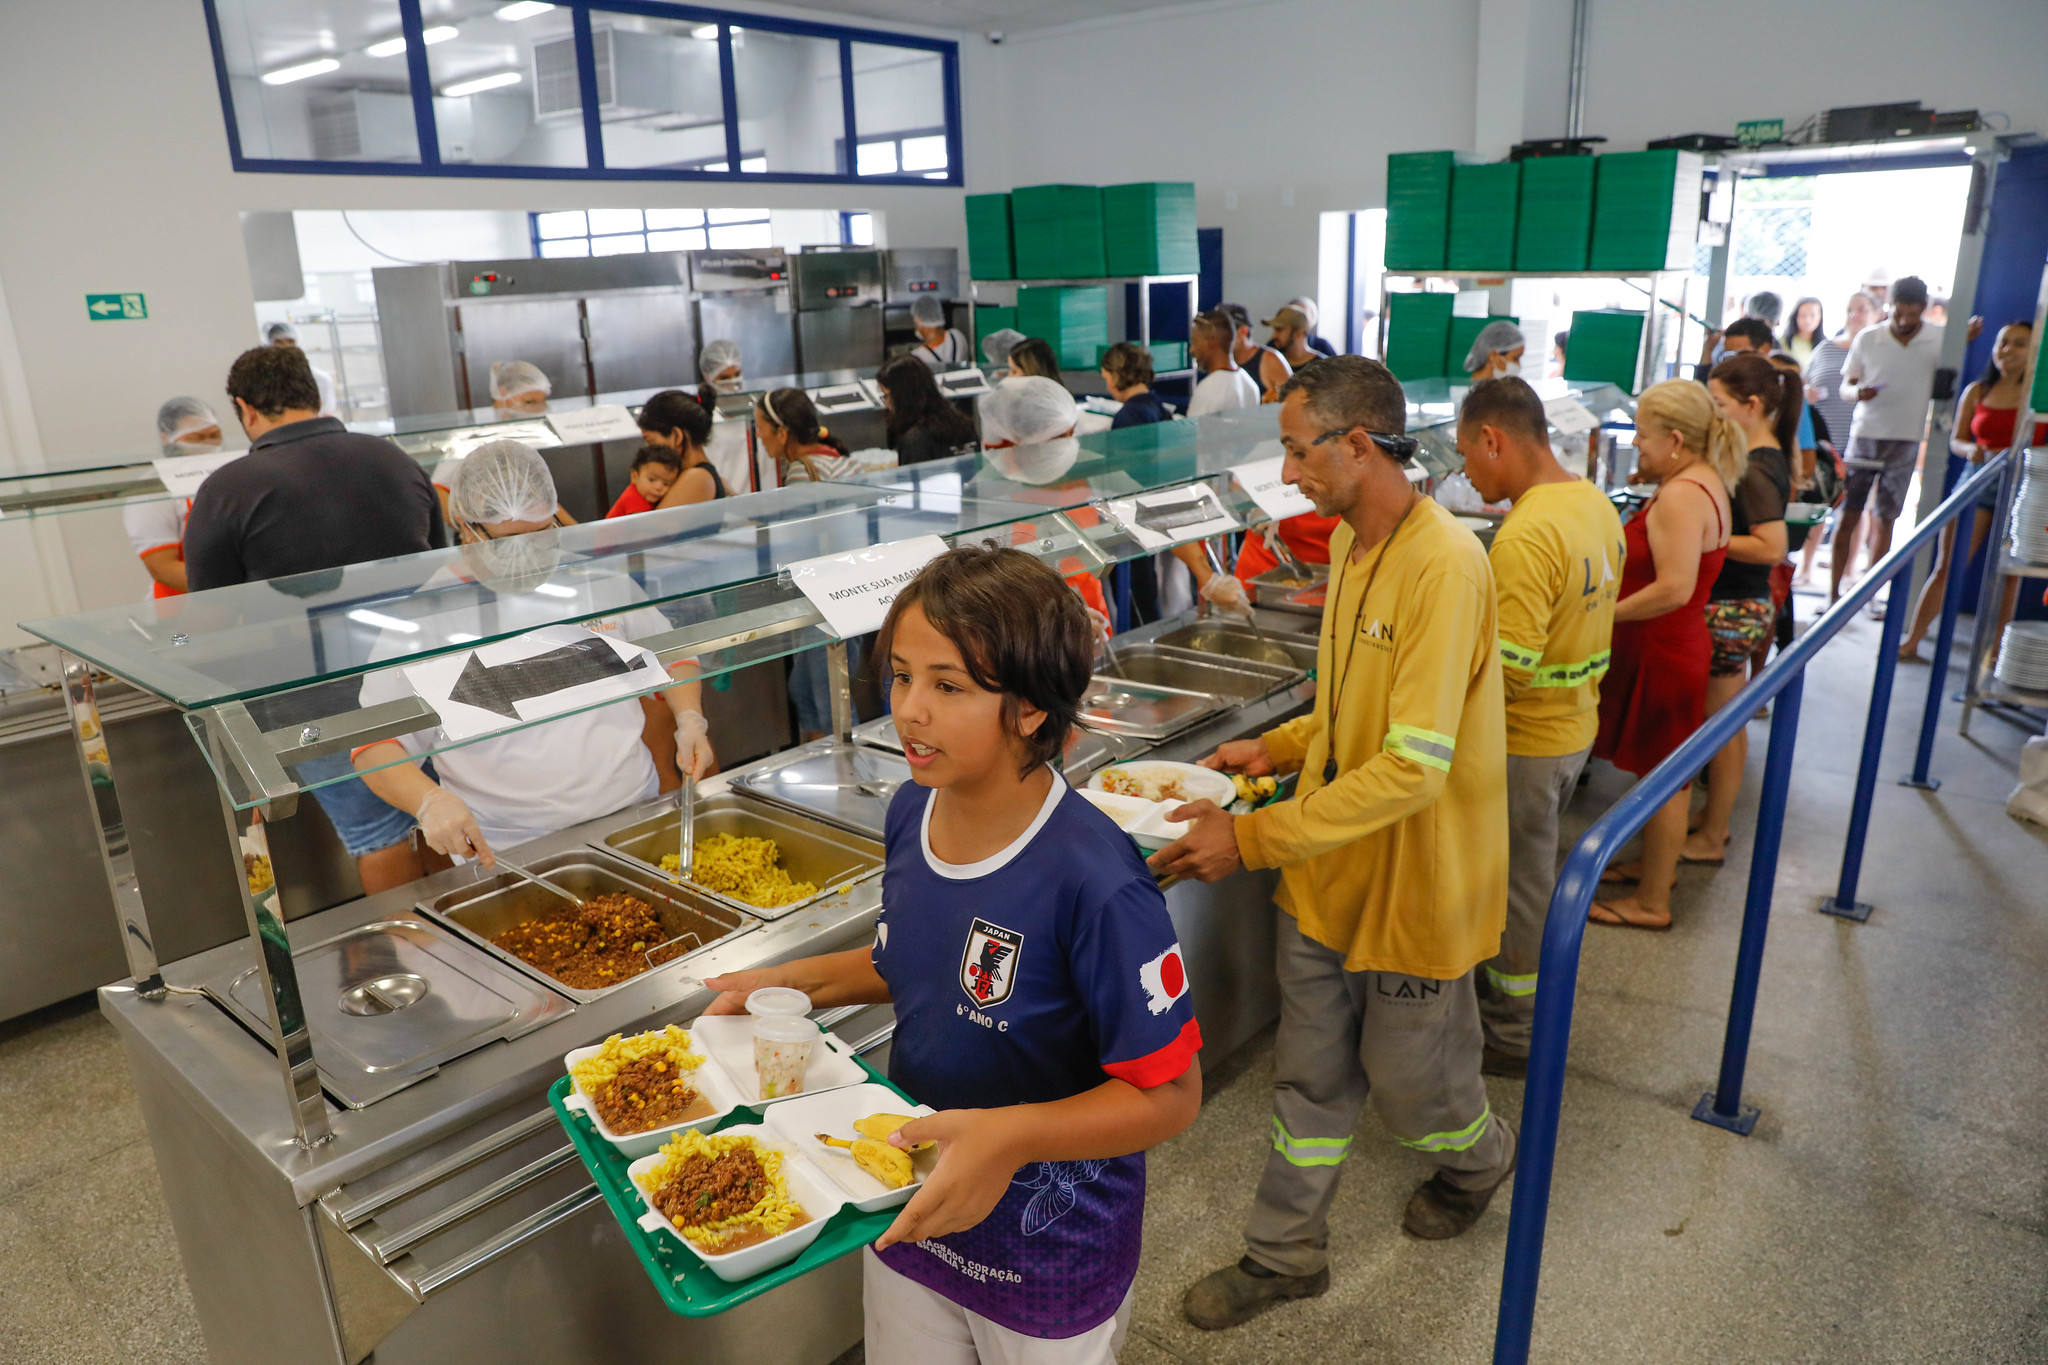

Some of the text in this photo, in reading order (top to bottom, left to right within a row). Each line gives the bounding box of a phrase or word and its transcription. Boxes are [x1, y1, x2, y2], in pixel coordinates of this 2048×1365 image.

[829, 583, 871, 601] MONTE
[870, 578, 893, 590] SUA
[1361, 614, 1393, 642] LAN
[983, 926, 1011, 940] JAPAN
[970, 979, 994, 997] JFA
[1377, 973, 1440, 999] LAN
[997, 1020, 1009, 1032] C
[961, 1265, 986, 1283] 2024
[967, 1260, 1022, 1284] CORAÇÃO
